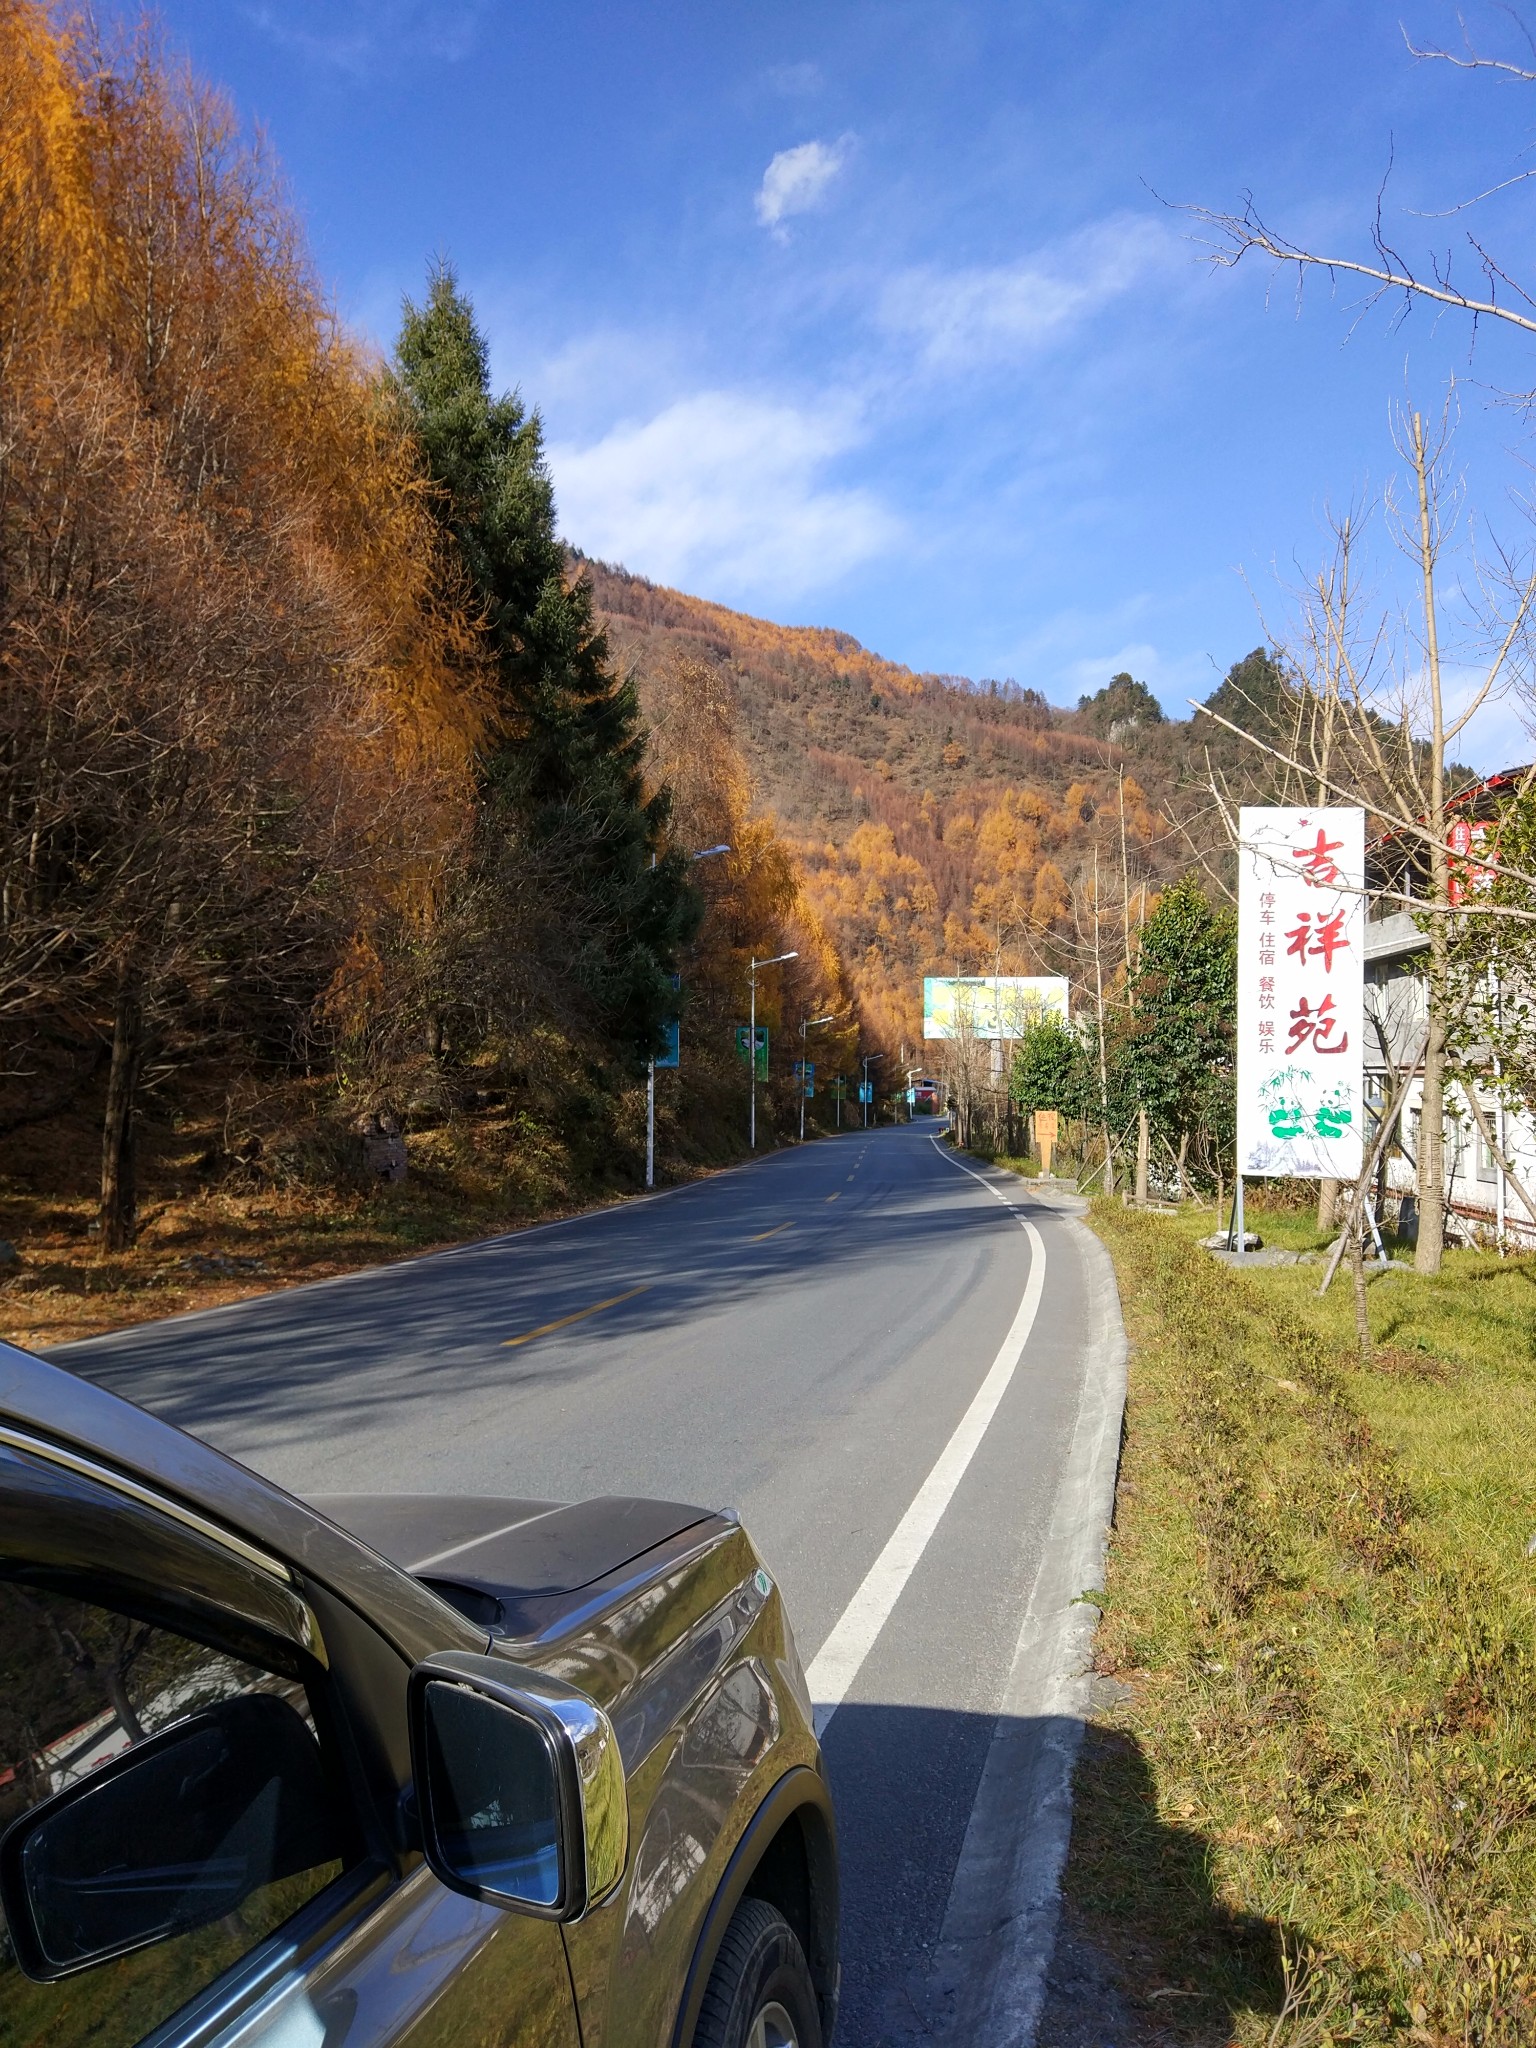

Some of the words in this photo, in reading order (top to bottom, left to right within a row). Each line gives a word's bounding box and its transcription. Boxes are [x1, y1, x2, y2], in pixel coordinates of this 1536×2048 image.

[1259, 892, 1276, 925] 停车
[1259, 932, 1276, 965] 住宿
[1284, 828, 1350, 1055] 吉祥苑
[1258, 976, 1275, 1009] 餐饮
[1258, 1021, 1275, 1054] 娱乐
